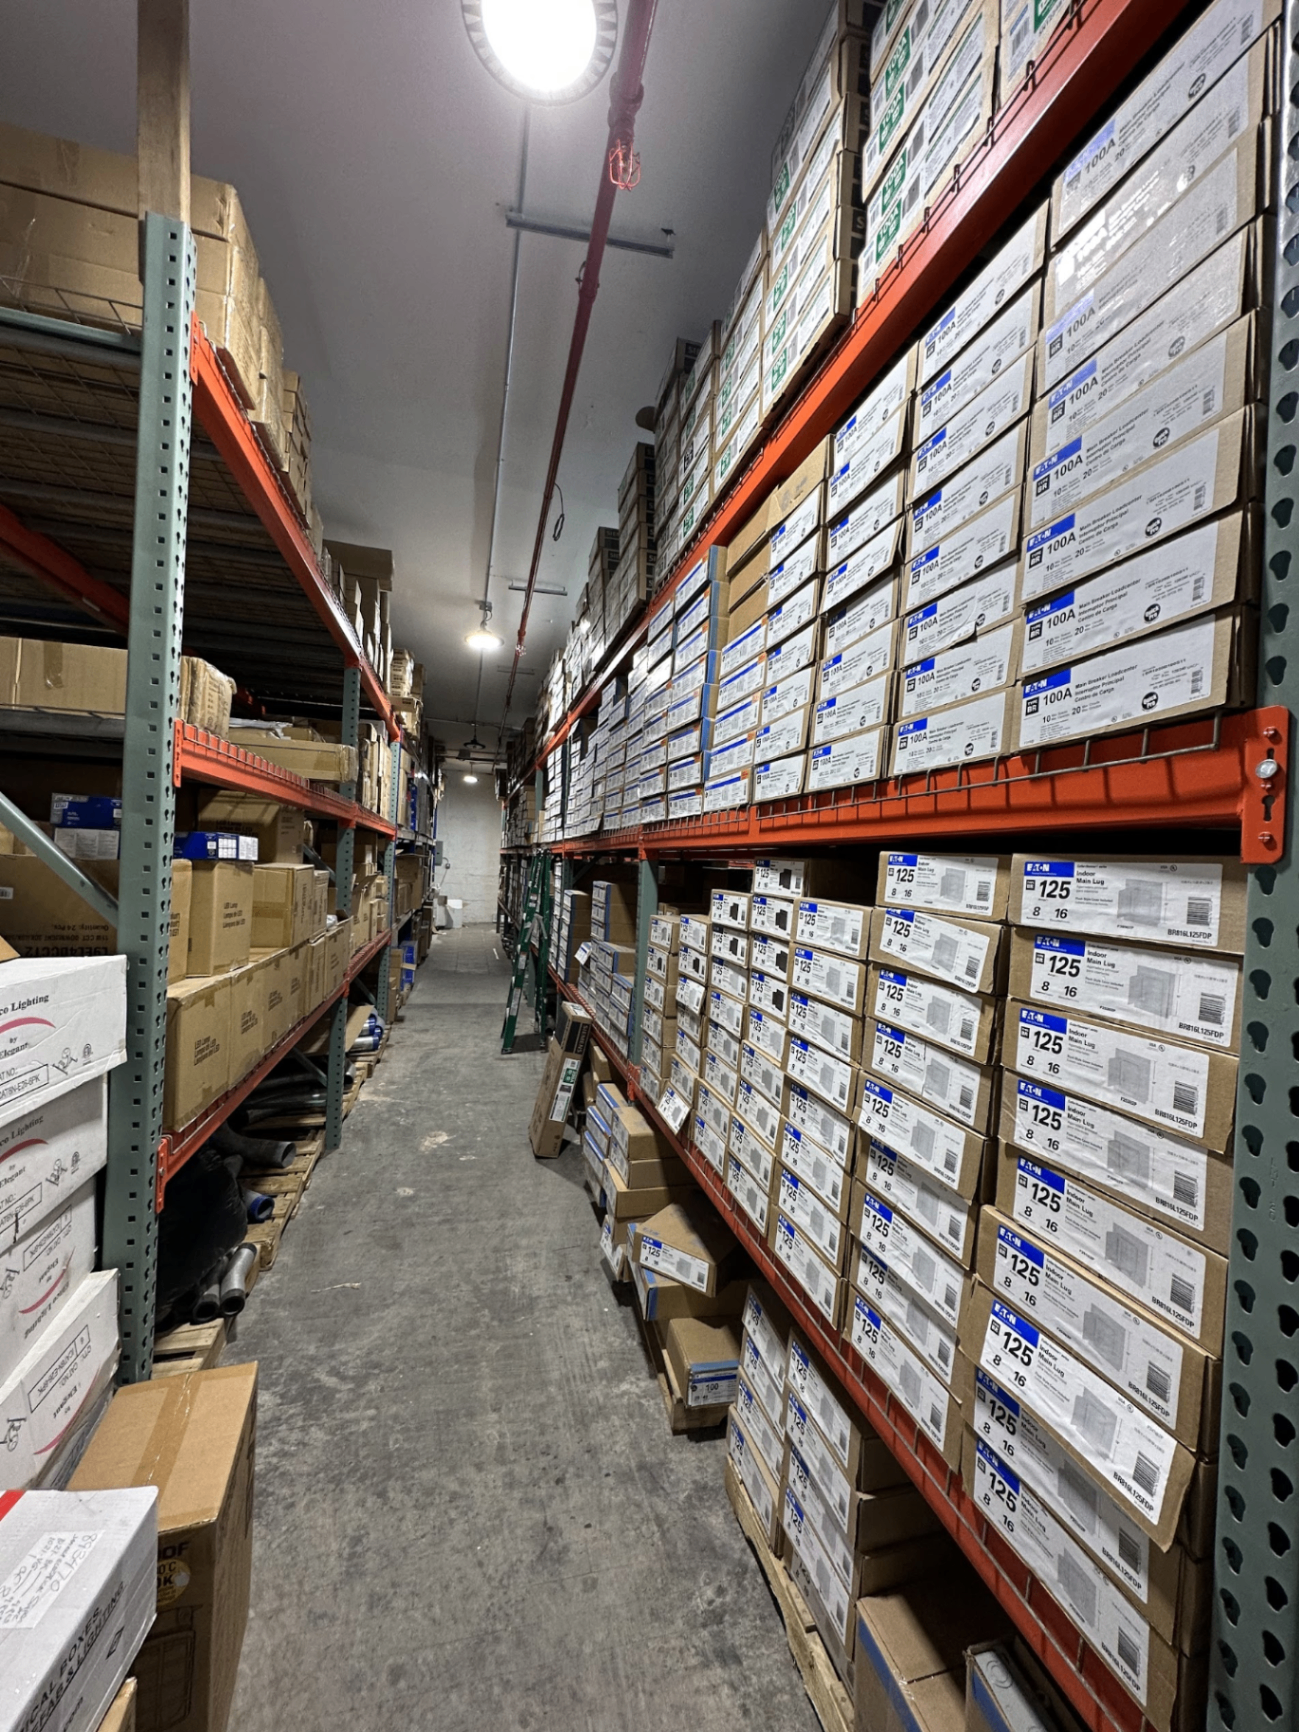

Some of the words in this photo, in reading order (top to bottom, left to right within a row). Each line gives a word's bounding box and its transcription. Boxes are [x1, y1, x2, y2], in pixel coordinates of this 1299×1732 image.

[1084, 139, 1116, 176] 100A
[1066, 308, 1096, 338] 100A
[1069, 376, 1099, 406] 100A
[1054, 454, 1083, 480] 100A
[1047, 532, 1076, 554] 100A
[1078, 601, 1091, 610] Main
[1111, 578, 1140, 596] Loadcenter
[920, 616, 938, 632] 100A
[1047, 608, 1076, 629] 100A
[918, 672, 935, 686] 100A
[1075, 681, 1087, 690] Main
[1088, 676, 1107, 686] Breaker
[1108, 664, 1138, 679] Loadcenter
[1102, 676, 1124, 688] Principal
[1043, 688, 1072, 706] 100A
[1100, 688, 1114, 696] Carga
[1042, 715, 1051, 724] 10
[1072, 706, 1081, 716] 20
[910, 732, 928, 744] 100A
[896, 868, 915, 883] 125
[1092, 878, 1104, 886] Lug
[891, 888, 897, 896] 8
[904, 889, 912, 898] 16
[1039, 880, 1071, 899] 125
[804, 912, 816, 926] 125
[1032, 906, 1040, 916] 8
[1054, 908, 1068, 919] 16
[892, 920, 911, 938] 125
[1167, 928, 1212, 940] BR816L125FDP
[886, 938, 892, 946] 8
[899, 943, 908, 952] 16
[1087, 950, 1107, 958] Indoor
[799, 958, 812, 974] 125
[1049, 955, 1082, 978] 125
[1087, 957, 1102, 966] Main
[1104, 960, 1116, 968] Lug
[886, 984, 904, 1002] 125
[1041, 981, 1050, 992] 8
[1064, 985, 1078, 998] 16
[11, 995, 49, 1012] Lighting
[796, 1002, 807, 1018] 125
[880, 1002, 886, 1011] 8
[892, 1007, 900, 1017] 16
[576, 1024, 590, 1054] SIEMENS
[1069, 1028, 1087, 1038] Indoor
[1178, 1022, 1224, 1040] BR816L125FDP
[884, 1039, 902, 1059] 125
[1033, 1030, 1064, 1054] 125
[1068, 1035, 1084, 1046] Main
[1084, 1040, 1096, 1050] Lug
[795, 1046, 807, 1064] 125
[878, 1057, 884, 1066] 8
[890, 1063, 899, 1073] 16
[1026, 1055, 1035, 1066] 8
[1047, 1061, 1060, 1075] 16
[796, 1094, 808, 1114] 125
[872, 1098, 890, 1118] 125
[1067, 1105, 1086, 1118] Indoor
[866, 1116, 872, 1124] 8
[878, 1123, 886, 1134] 16
[1032, 1104, 1062, 1131] 125
[1067, 1112, 1082, 1125] Main
[1083, 1118, 1094, 1130] Lug
[11, 1116, 44, 1141] Lighting
[788, 1134, 800, 1154] 125
[1026, 1128, 1034, 1140] 8
[1047, 1138, 1060, 1151] 16
[877, 1156, 894, 1177] 125
[786, 1182, 798, 1202] 125
[1031, 1184, 1062, 1213] 125
[1066, 1189, 1085, 1204] Indoor
[1066, 1196, 1082, 1212] Main
[1082, 1204, 1094, 1218] Lug
[871, 1213, 889, 1238] 125
[1024, 1206, 1033, 1218] 8
[1045, 1218, 1058, 1233] 16
[781, 1230, 793, 1250] 125
[648, 1244, 660, 1258] 125
[867, 1260, 885, 1286] 125
[1010, 1254, 1040, 1286] 125
[1045, 1262, 1064, 1281] Indoor
[1004, 1276, 1012, 1288] 8
[1024, 1290, 1037, 1307] 16
[1045, 1272, 1060, 1288] Main
[1060, 1282, 1072, 1296] Lug
[861, 1318, 879, 1345] 125
[1002, 1331, 1035, 1367] 125
[1040, 1344, 1058, 1362] Indoor
[992, 1354, 1002, 1366] 8
[1013, 1370, 1026, 1388] 16
[1038, 1351, 1054, 1368] Main
[1054, 1364, 1065, 1378] Lug
[988, 1398, 1017, 1436] 125
[982, 1422, 991, 1434] 8
[1002, 1440, 1014, 1457] 16
[988, 1471, 1017, 1514] 125
[982, 1493, 991, 1507] 8
[1002, 1514, 1014, 1533] 16
[78, 1580, 124, 1667] LIGHTING
[60, 1606, 99, 1678] BOXES
